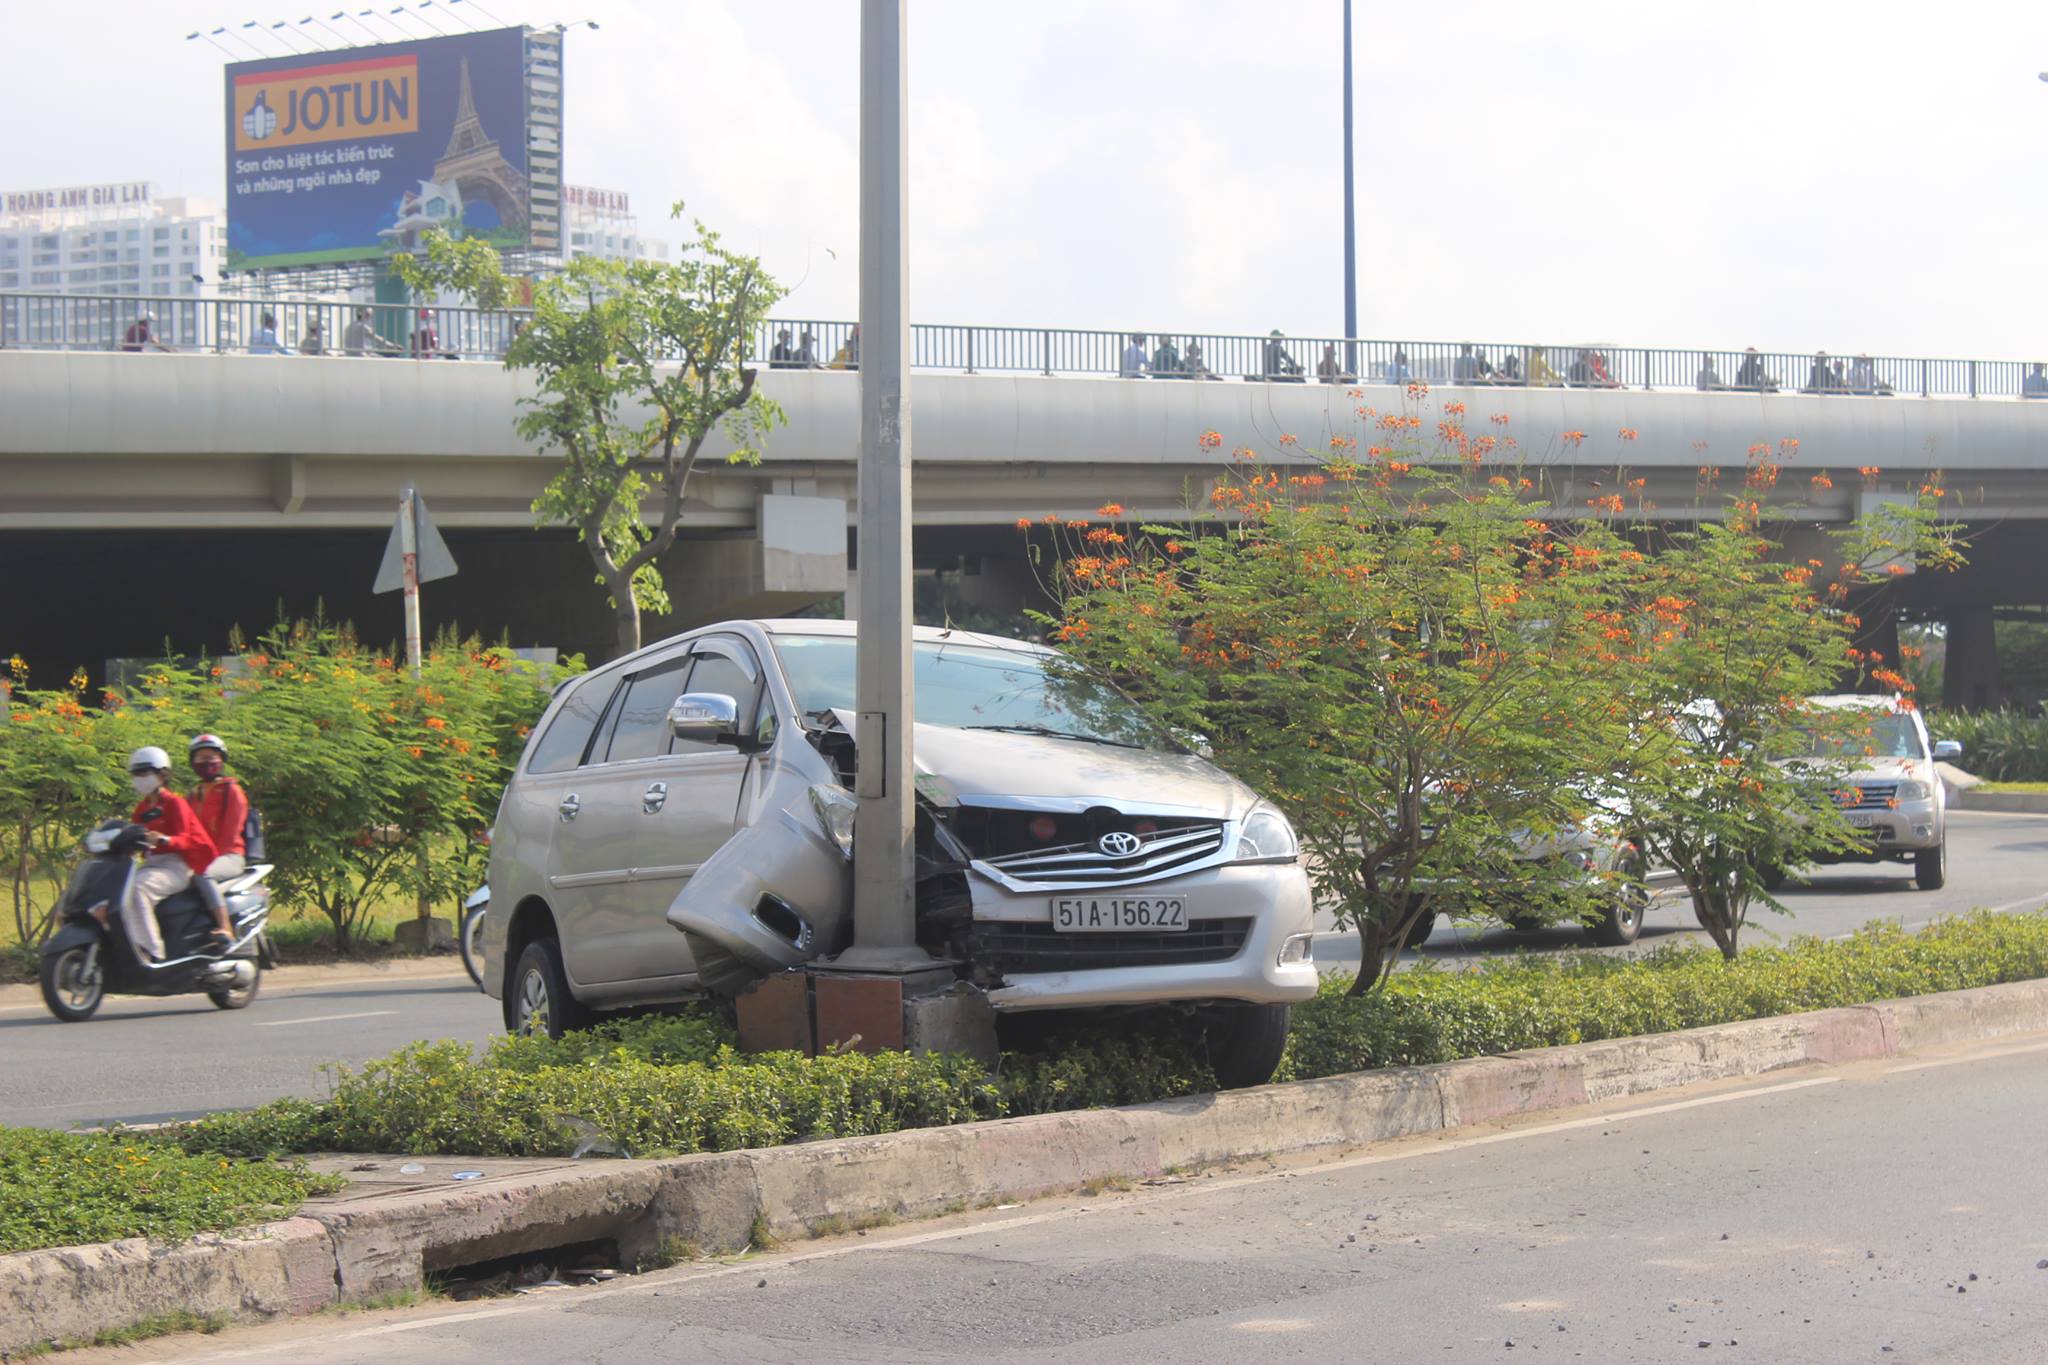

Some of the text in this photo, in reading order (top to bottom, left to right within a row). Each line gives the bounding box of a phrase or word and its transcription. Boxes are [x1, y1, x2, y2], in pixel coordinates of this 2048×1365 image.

[282, 77, 408, 136] JOTUN
[261, 155, 285, 171] cho
[287, 152, 312, 170] kiệt
[315, 149, 335, 165] tác
[337, 145, 365, 164] kiến
[367, 143, 394, 160] trúc
[92, 187, 115, 205] GIA
[121, 184, 147, 203] LAI
[235, 179, 251, 195] và
[296, 171, 326, 191] ngôi
[327, 168, 353, 185] nhà
[355, 167, 381, 185] đẹp
[1059, 900, 1182, 926] 51A-156.22
